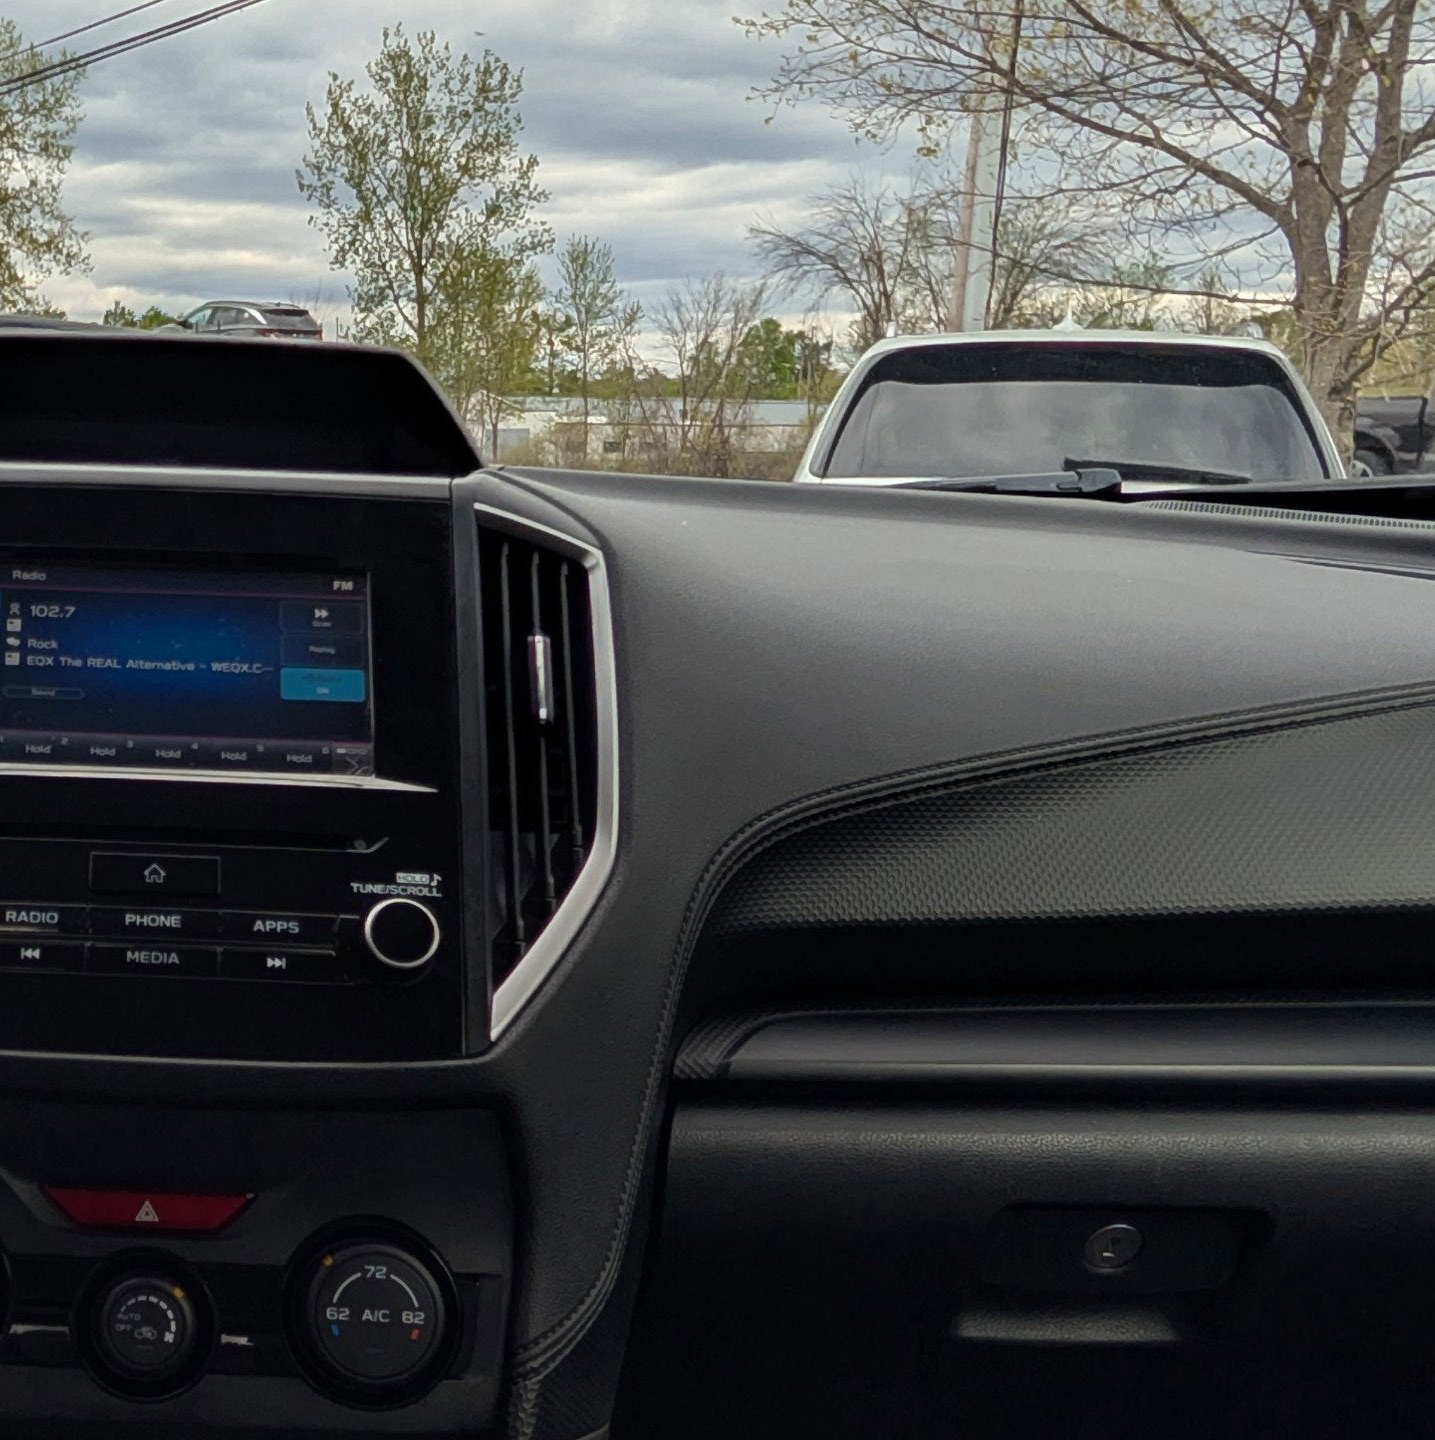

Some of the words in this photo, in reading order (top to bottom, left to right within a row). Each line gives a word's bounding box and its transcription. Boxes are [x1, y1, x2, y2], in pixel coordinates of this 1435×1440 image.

[12, 570, 46, 582] Radio
[333, 580, 353, 591] FM
[29, 605, 76, 619] 102.7
[27, 638, 58, 650] Rock
[26, 656, 54, 667] EQX
[60, 657, 82, 668] The
[87, 657, 121, 669] REAL
[126, 659, 195, 672] Alternative
[25, 745, 51, 754] Hold
[90, 746, 116, 756] Hold
[155, 749, 181, 759] Hold
[221, 751, 247, 761] Hold
[286, 754, 312, 763] Hold
[398, 873, 430, 883] HOLD
[350, 883, 442, 898] TUNE/SCROLL
[5, 910, 59, 925] RADIO
[124, 914, 182, 928] PHONE
[252, 919, 300, 934] APPS
[126, 951, 180, 965] MEDIA
[364, 1265, 387, 1279] 72
[326, 1307, 350, 1321] 62
[361, 1309, 390, 1323] A/C
[401, 1311, 425, 1325] 82
